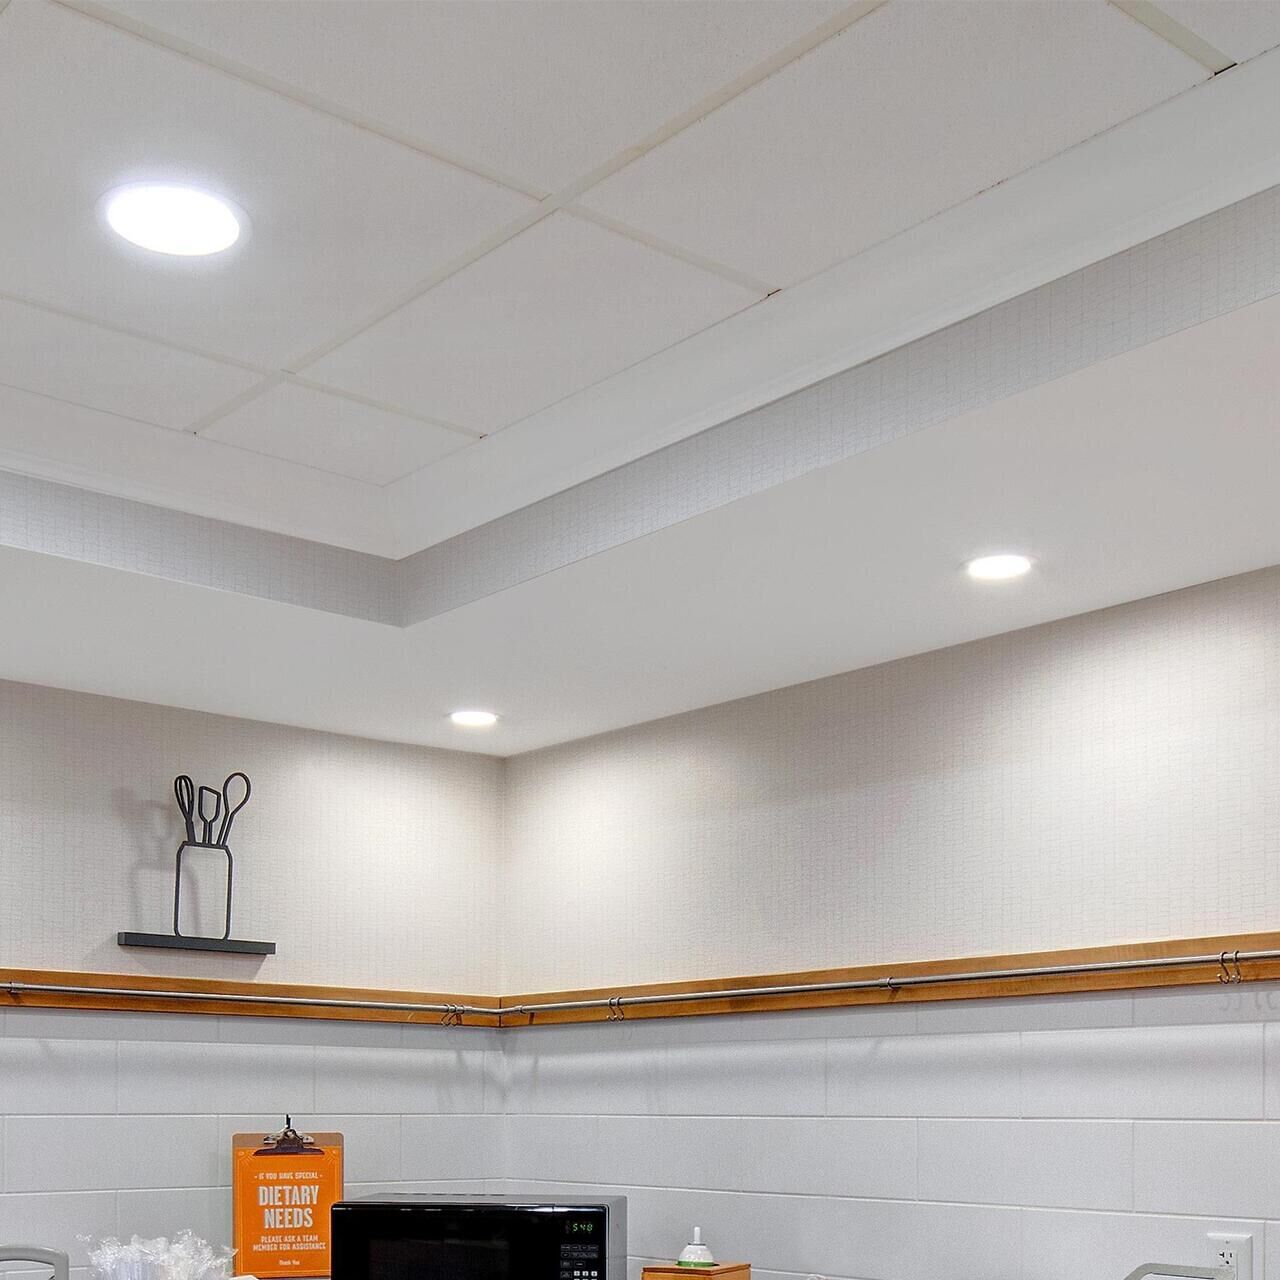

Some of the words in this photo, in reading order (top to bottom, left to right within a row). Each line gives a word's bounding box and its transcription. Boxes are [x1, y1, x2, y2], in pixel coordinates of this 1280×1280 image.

[295, 1171, 318, 1179] SPECIAL
[258, 1185, 319, 1206] DIETARY
[264, 1208, 313, 1228] NEEDS
[261, 1235, 282, 1243] PLEASE
[303, 1234, 318, 1242] TEAM
[292, 1242, 326, 1250] ASSISTANCE
